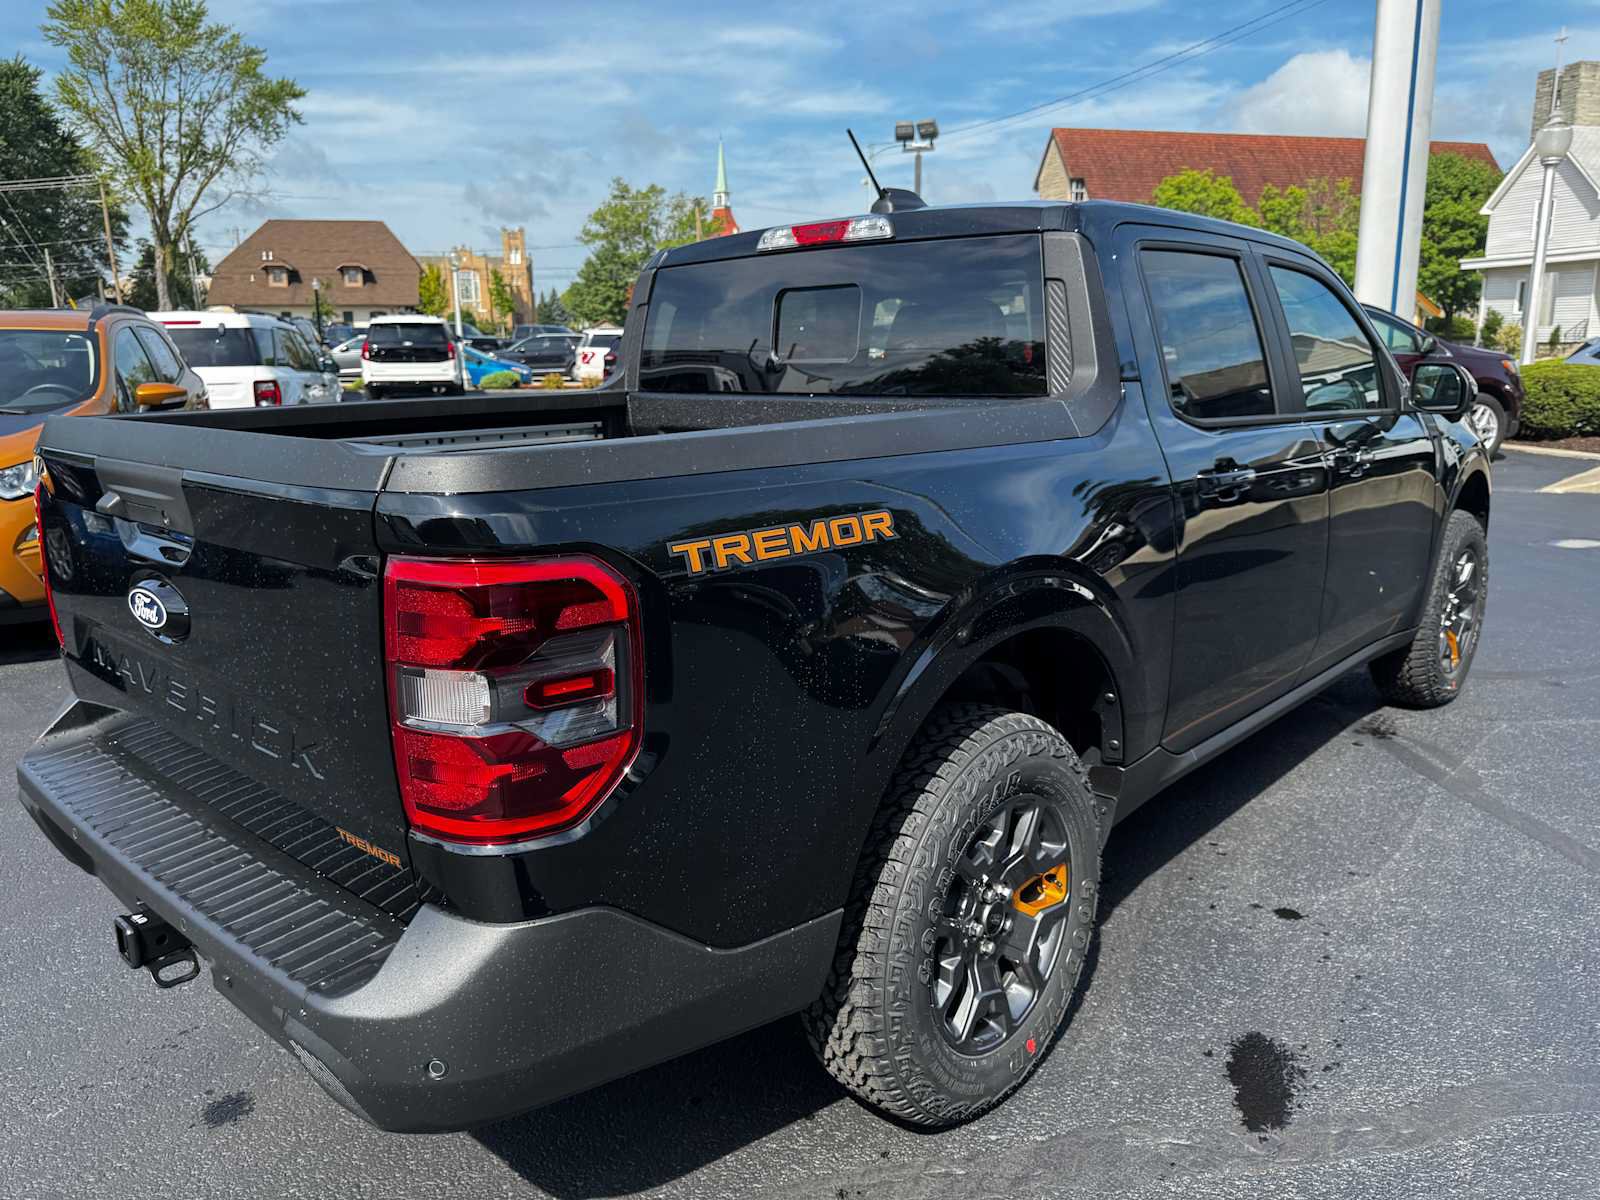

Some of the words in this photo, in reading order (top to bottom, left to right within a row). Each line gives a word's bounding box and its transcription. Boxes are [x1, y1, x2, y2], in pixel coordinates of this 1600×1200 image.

[668, 509, 897, 575] TREMOR
[134, 592, 158, 624] Ford
[335, 826, 404, 871] TREMOR
